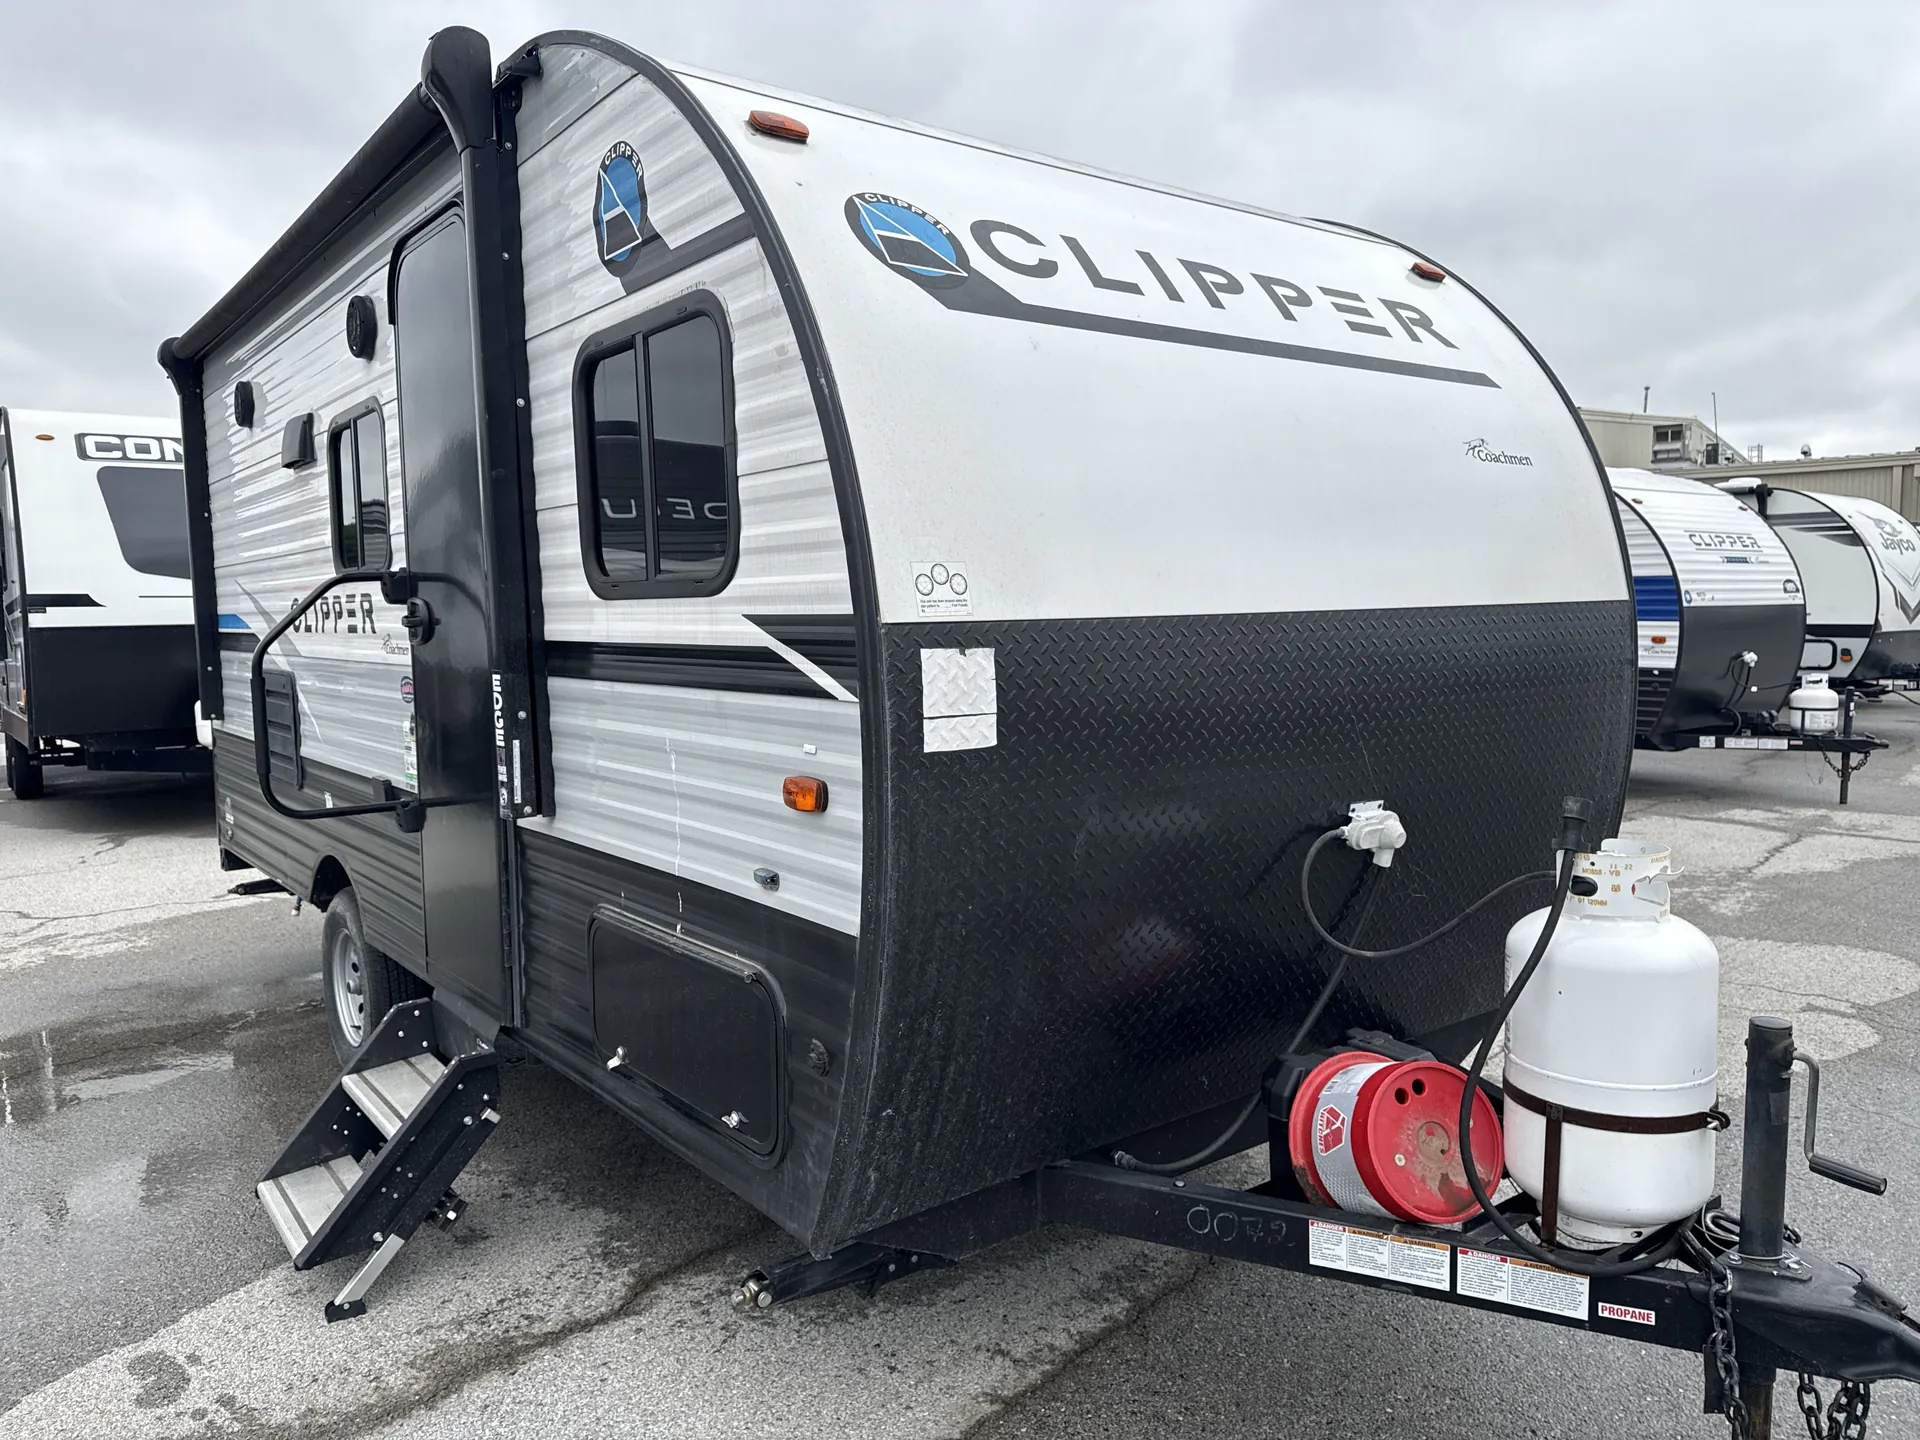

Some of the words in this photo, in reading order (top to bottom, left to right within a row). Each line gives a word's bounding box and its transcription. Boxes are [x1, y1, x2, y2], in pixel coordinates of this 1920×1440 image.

[603, 140, 644, 181] CLIPPER
[864, 192, 951, 236] CLIPPER
[969, 218, 1460, 351] CLIPPER
[1476, 449, 1534, 467] Coachmen
[1687, 533, 1763, 550] CLIPPER
[1878, 531, 1917, 556] Jayco
[491, 673, 506, 747] EDGE
[1318, 1221, 1344, 1233] DANGER
[1407, 1238, 1437, 1249] WARNING
[1472, 1251, 1502, 1262] DANGER
[1600, 1304, 1653, 1323] PROPANE
